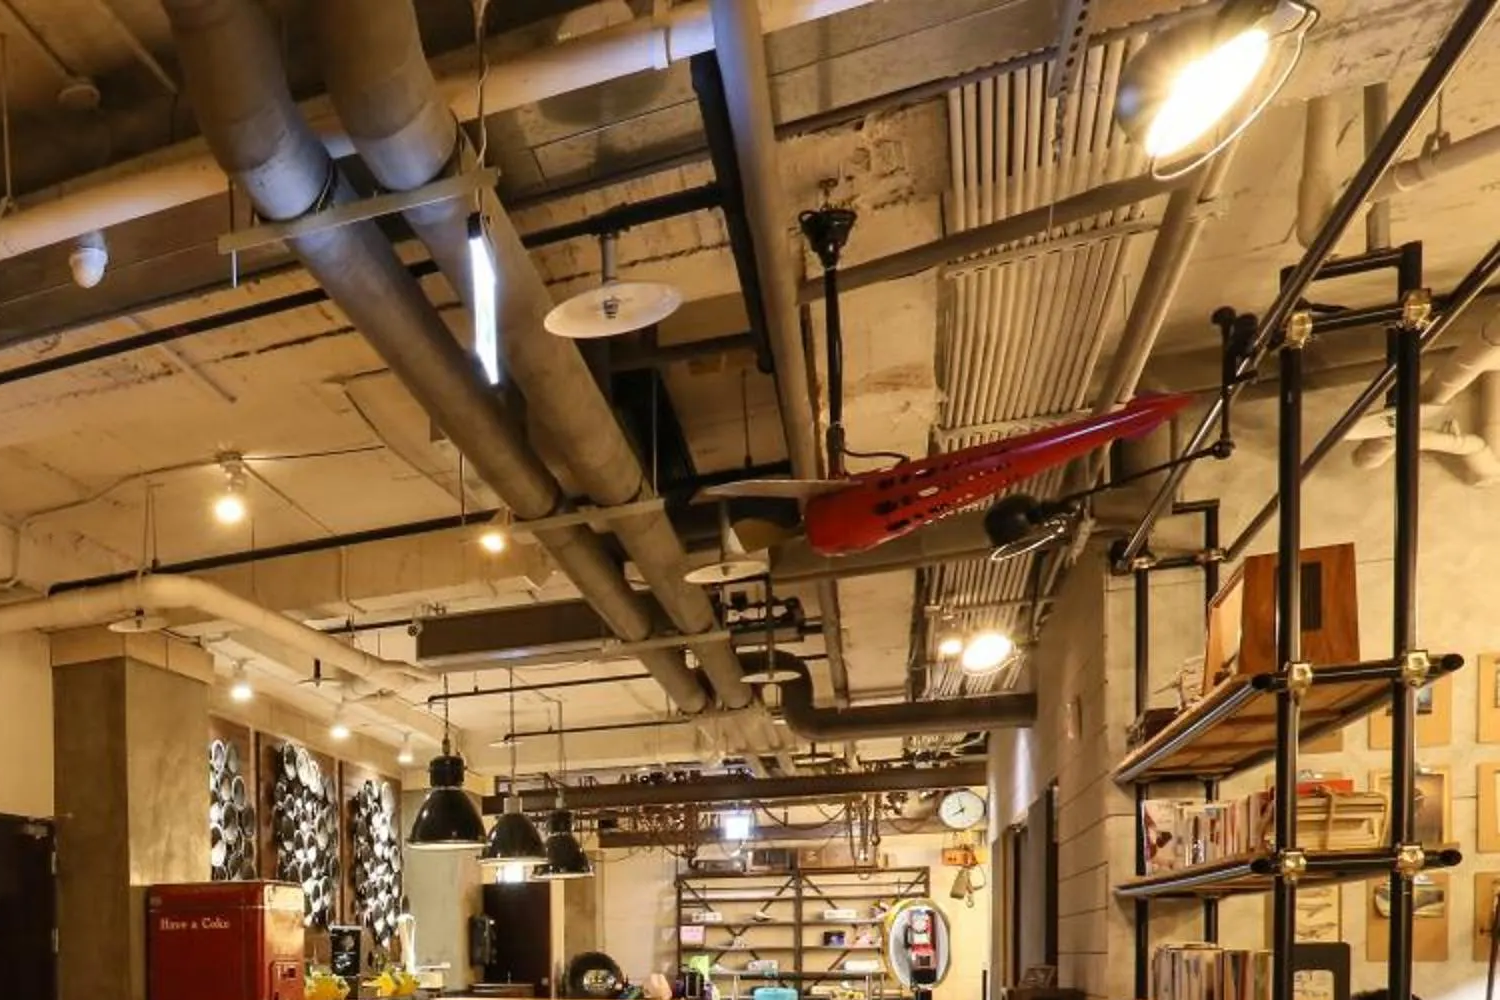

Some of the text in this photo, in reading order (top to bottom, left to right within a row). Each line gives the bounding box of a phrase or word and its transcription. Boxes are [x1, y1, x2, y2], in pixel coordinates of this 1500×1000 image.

[160, 916, 231, 930] Have a Coke
